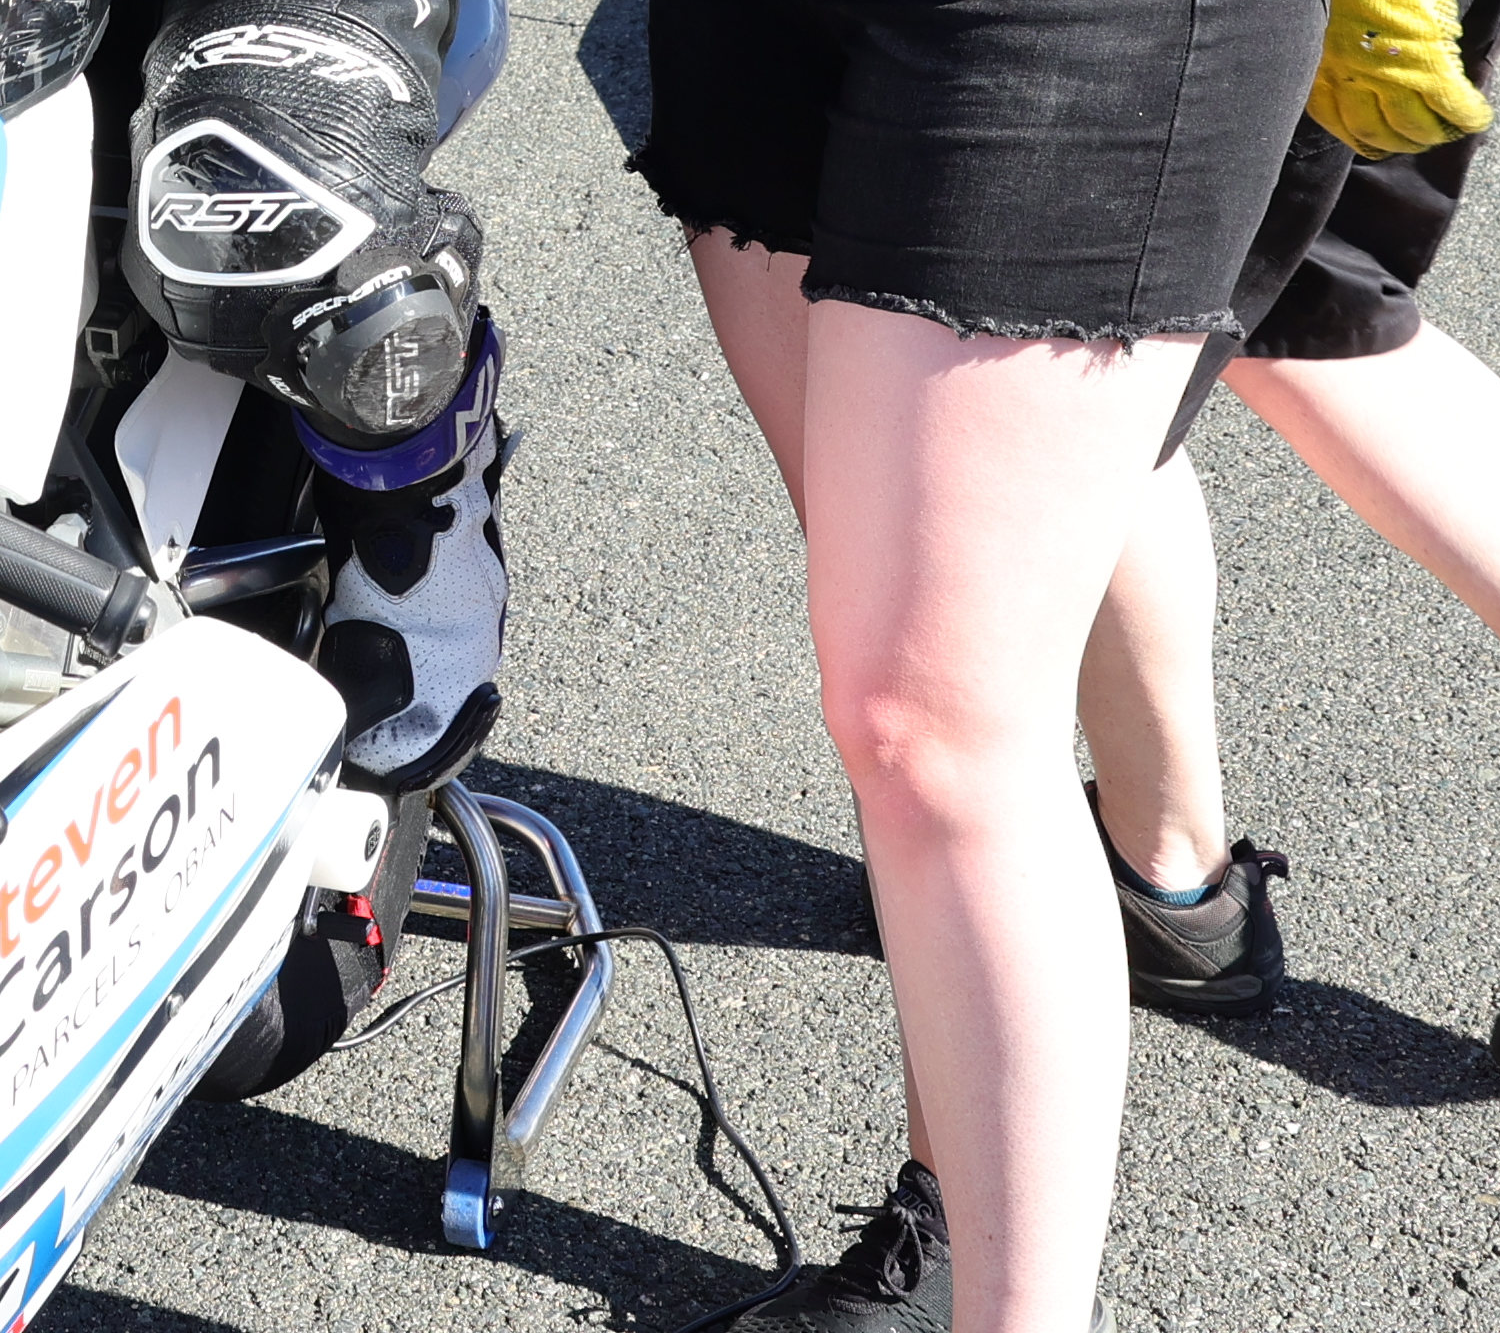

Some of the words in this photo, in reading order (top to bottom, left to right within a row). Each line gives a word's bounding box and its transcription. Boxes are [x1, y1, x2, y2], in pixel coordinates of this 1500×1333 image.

[150, 192, 322, 232] RST
[12, 924, 142, 1107] PARCELS
[164, 792, 236, 914] OBAN
